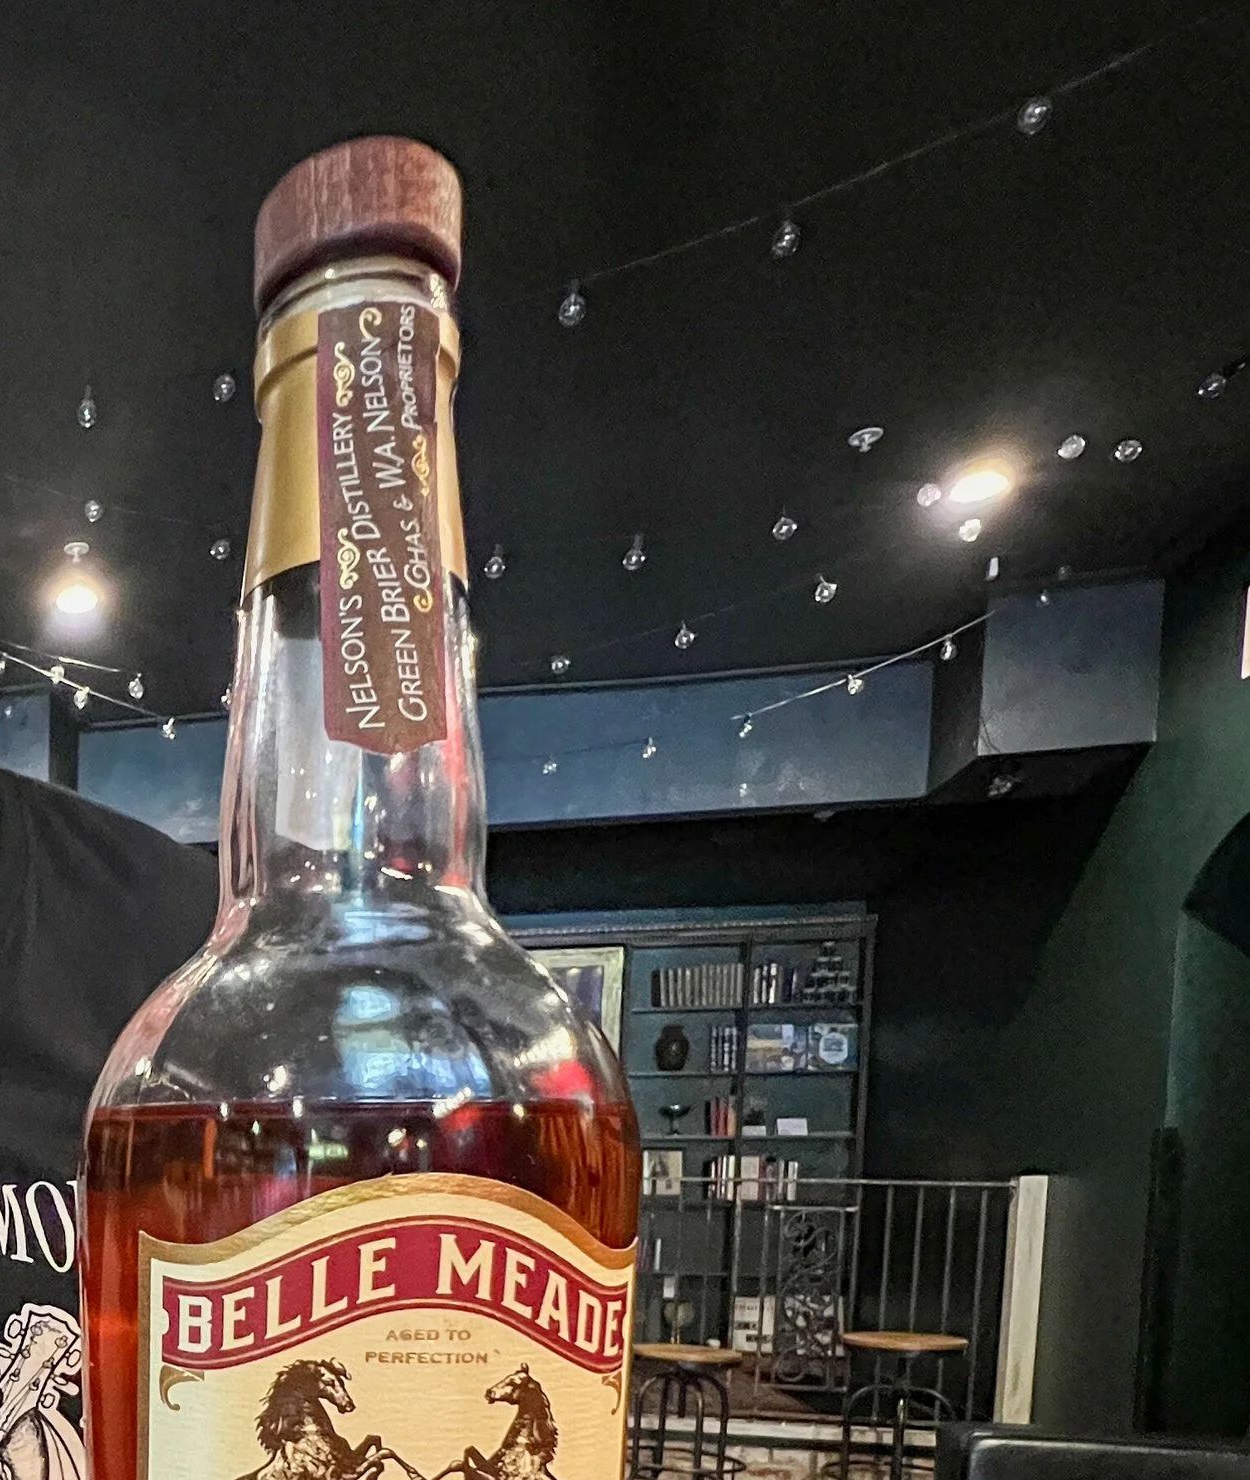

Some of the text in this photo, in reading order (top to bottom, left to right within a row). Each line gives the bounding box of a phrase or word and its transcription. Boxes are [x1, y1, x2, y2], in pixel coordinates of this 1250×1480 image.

[359, 336, 396, 433] NELSON
[397, 303, 423, 432] PROPRIETORS
[332, 412, 429, 722] GREEN BRIER DISTILLERY
[337, 594, 386, 729] NELSON'S
[177, 1232, 623, 1357] BELLE MEADE
[385, 1329, 472, 1341] AGED TO
[365, 1351, 488, 1364] PERFECTION
